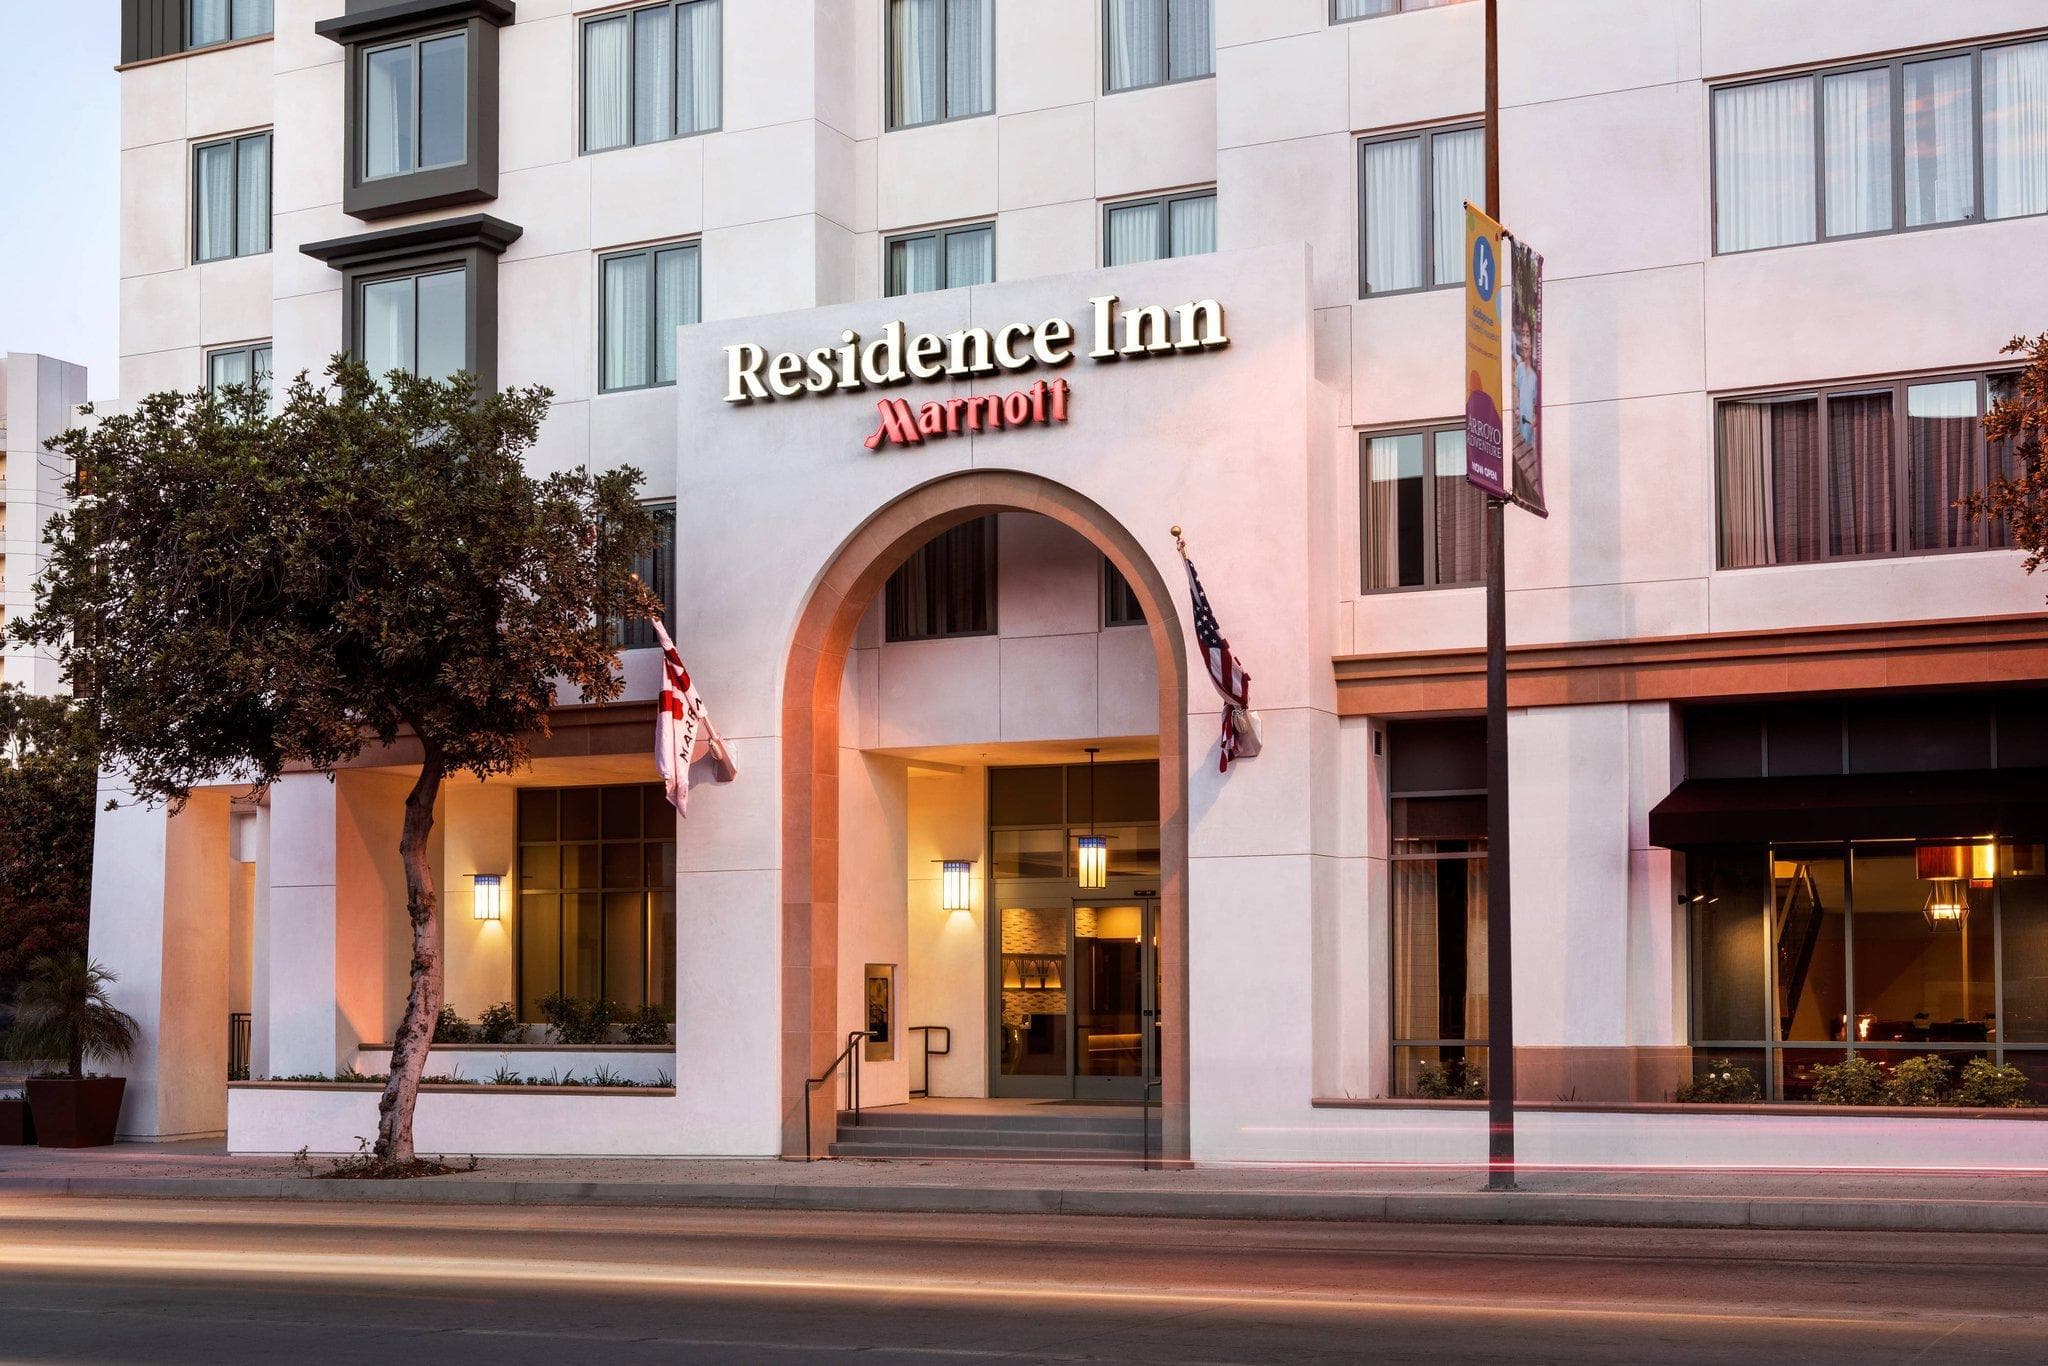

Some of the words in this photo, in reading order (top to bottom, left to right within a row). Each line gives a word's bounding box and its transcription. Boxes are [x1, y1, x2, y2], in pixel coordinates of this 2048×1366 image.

[722, 319, 1075, 405] Residence
[1088, 295, 1230, 360] Inn
[864, 377, 1070, 451] Marriott
[1467, 415, 1502, 445] ARROYO
[1467, 433, 1503, 459] ADVENTURE
[1472, 461, 1484, 475] NOW
[1484, 467, 1498, 481] OPEN
